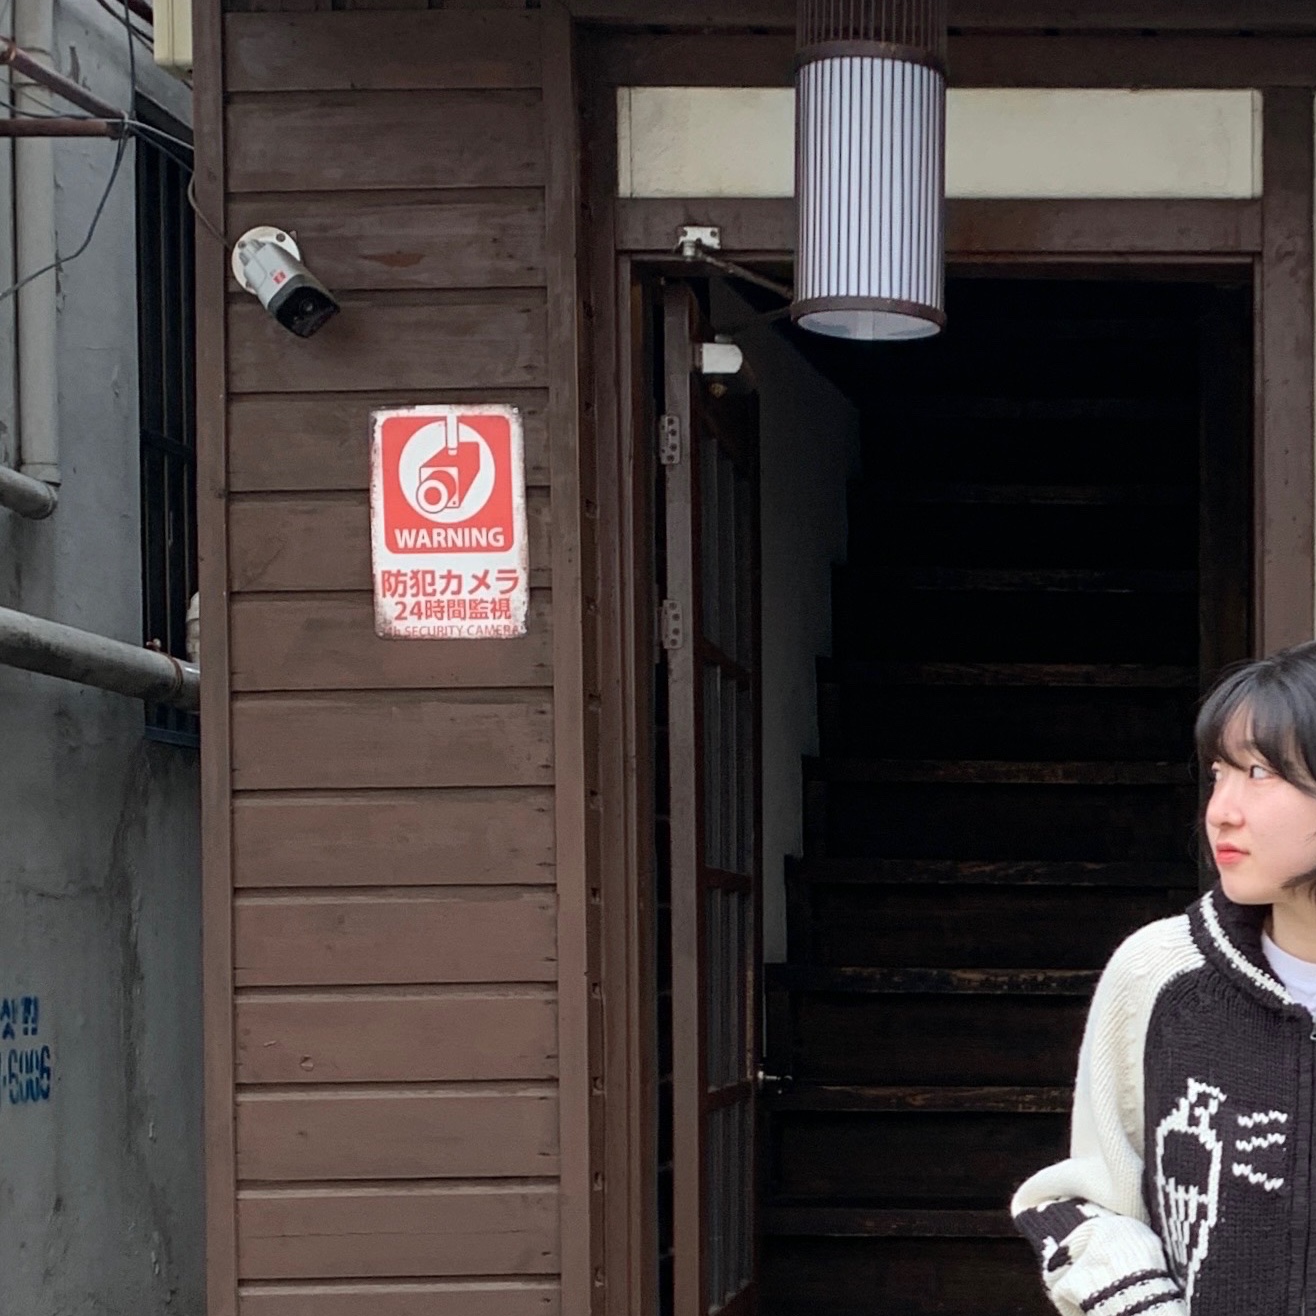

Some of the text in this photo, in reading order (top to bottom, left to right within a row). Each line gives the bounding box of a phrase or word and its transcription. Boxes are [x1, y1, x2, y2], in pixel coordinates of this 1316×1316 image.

[394, 527, 505, 549] WARNING
[381, 569, 520, 599] 防犯カメラ
[394, 598, 512, 621] 24時間監視
[405, 625, 463, 637] SECURITY
[467, 624, 519, 636] CAMERA
